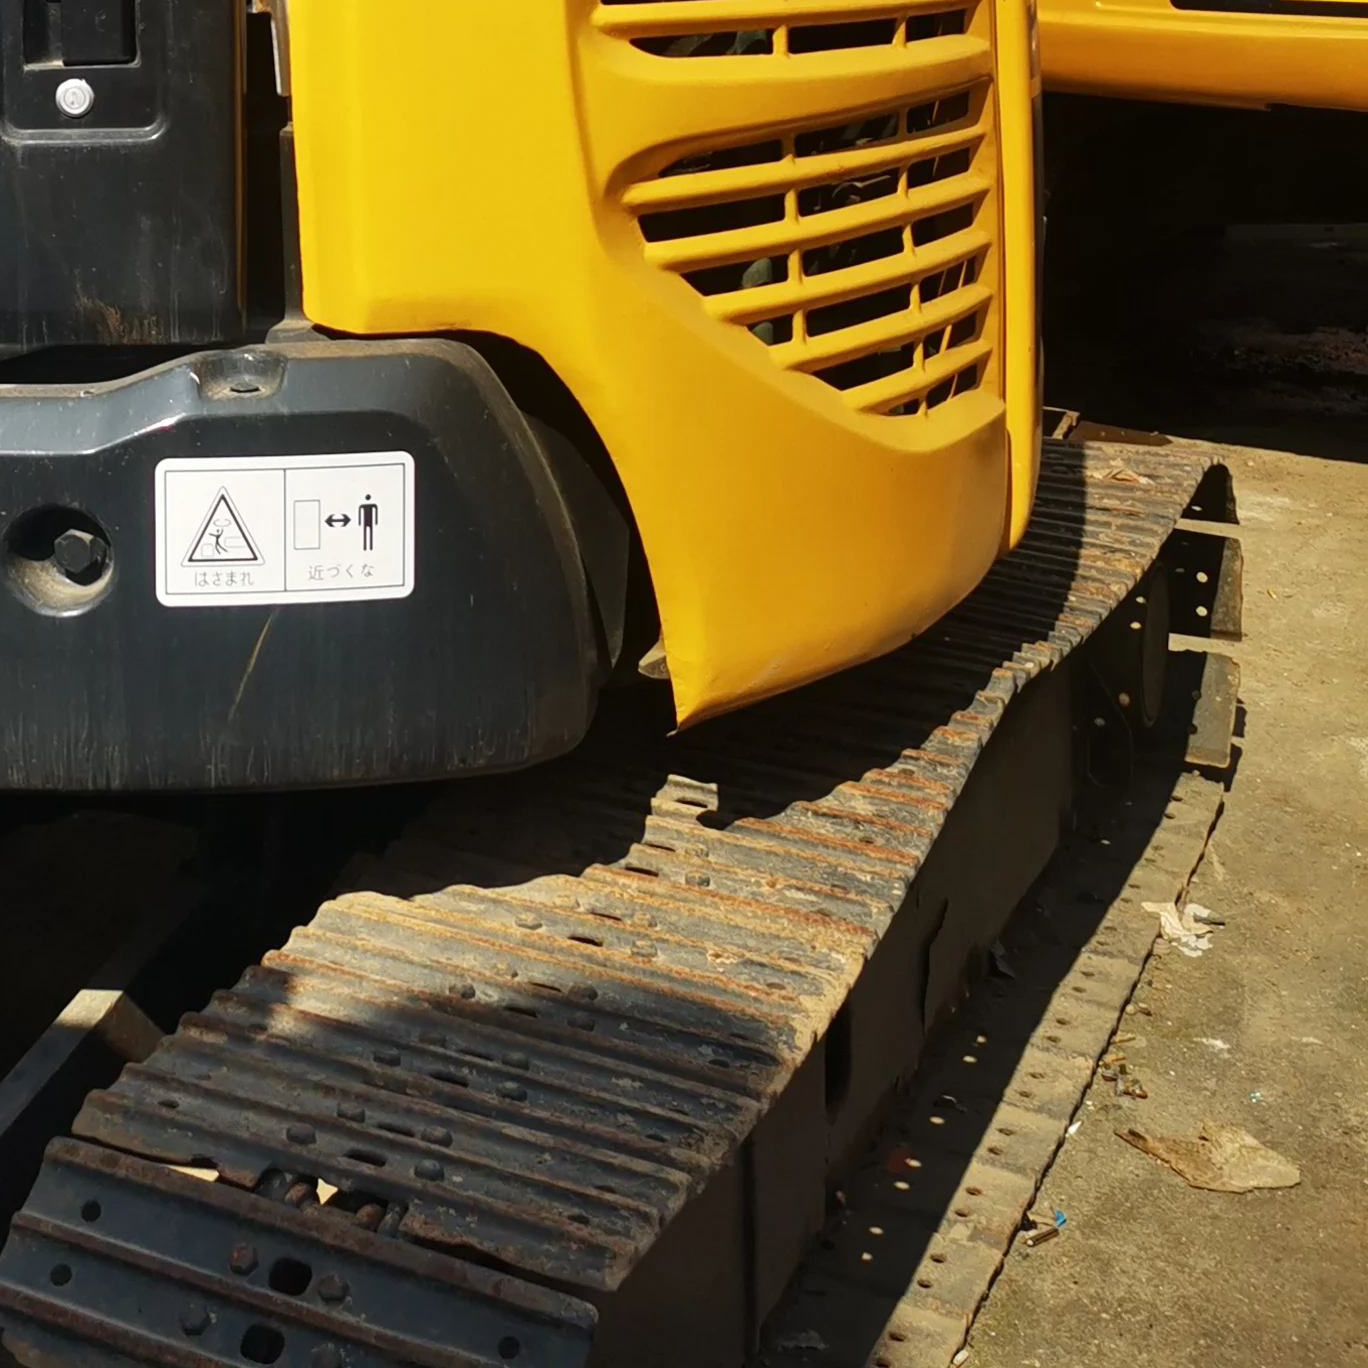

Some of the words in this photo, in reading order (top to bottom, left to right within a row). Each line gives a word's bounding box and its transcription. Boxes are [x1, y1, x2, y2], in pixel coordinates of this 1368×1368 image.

[195, 571, 254, 586] はさまれ
[309, 564, 375, 581] 近づくな
